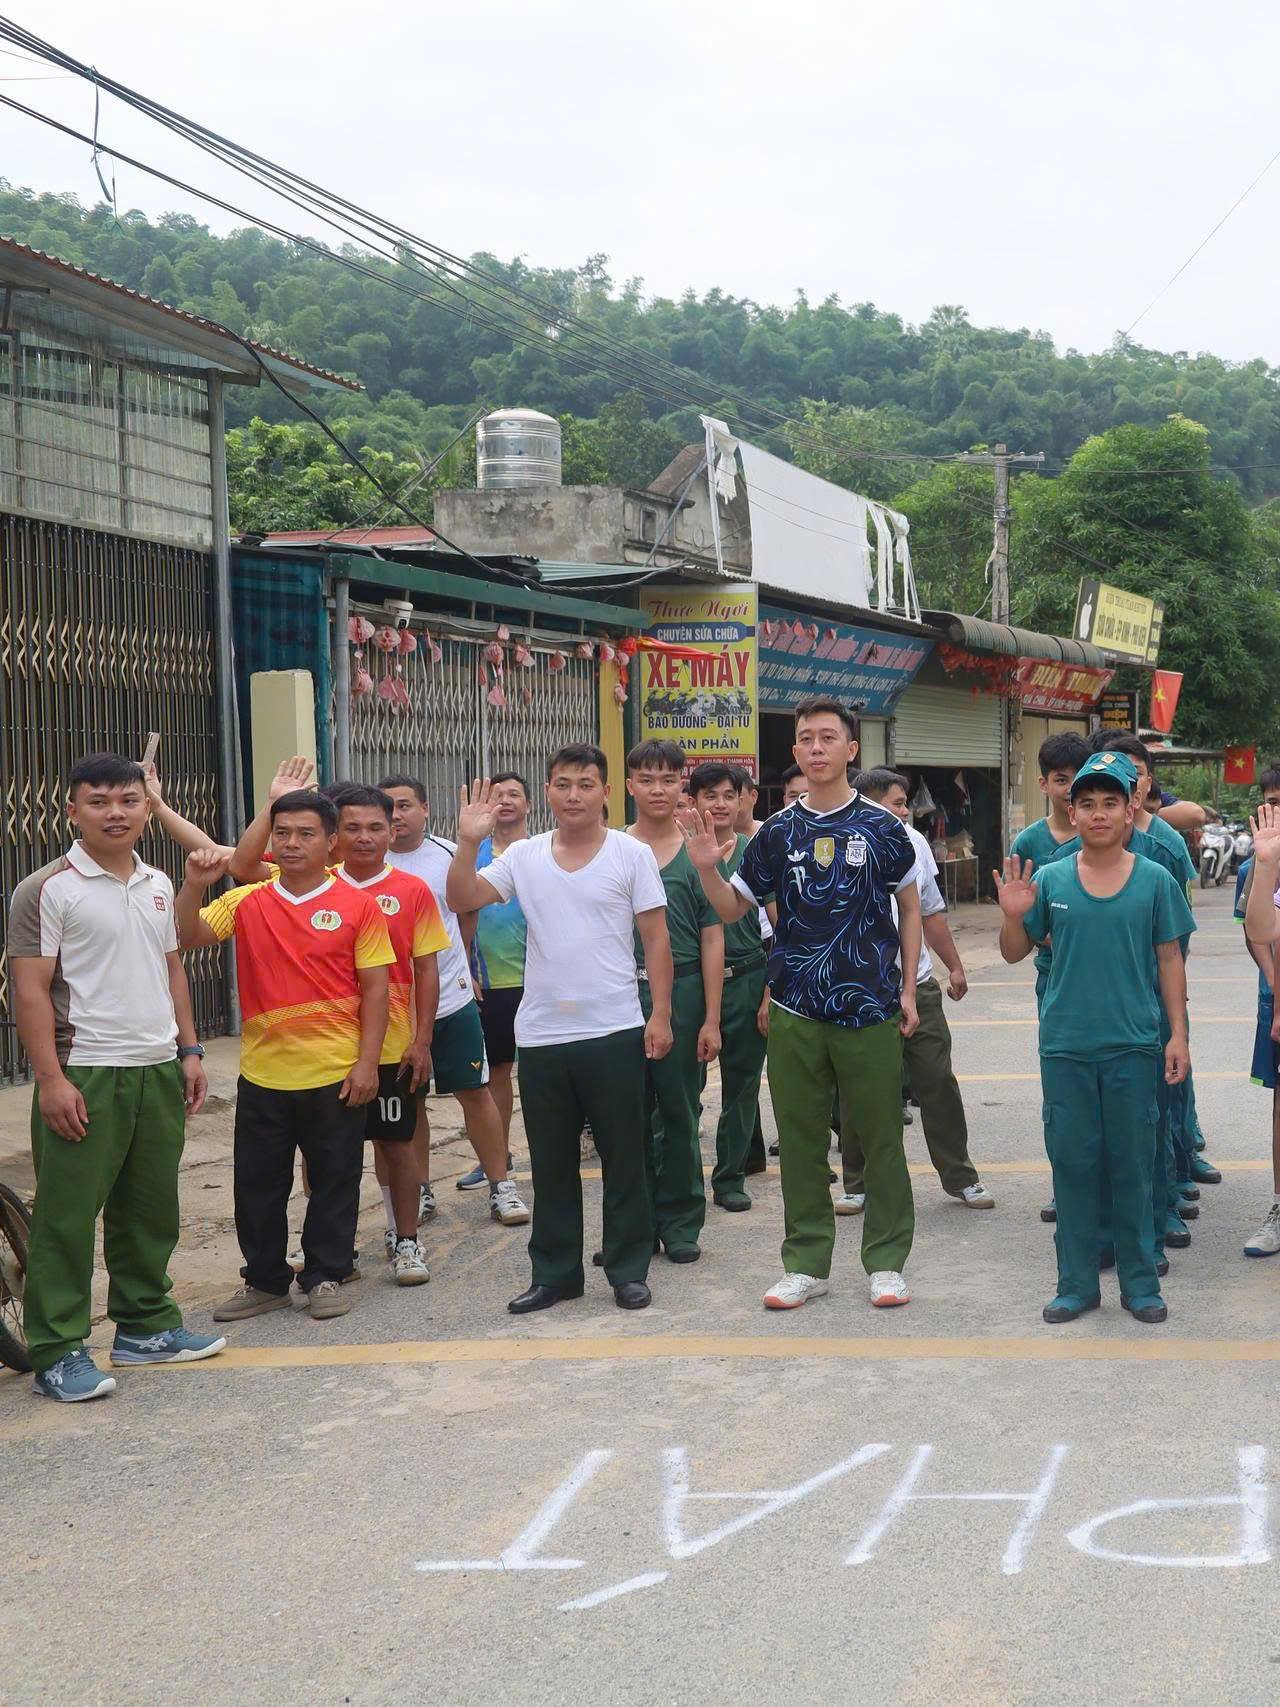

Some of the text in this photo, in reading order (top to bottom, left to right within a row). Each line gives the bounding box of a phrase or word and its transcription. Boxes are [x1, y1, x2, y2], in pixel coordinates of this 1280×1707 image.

[657, 624, 739, 641] CHUYÊN SỬA CHỮA
[647, 652, 681, 688] XE
[691, 644, 750, 688] MÁY
[679, 734, 739, 750] ÀN PHẦN
[378, 1096, 401, 1122] 10
